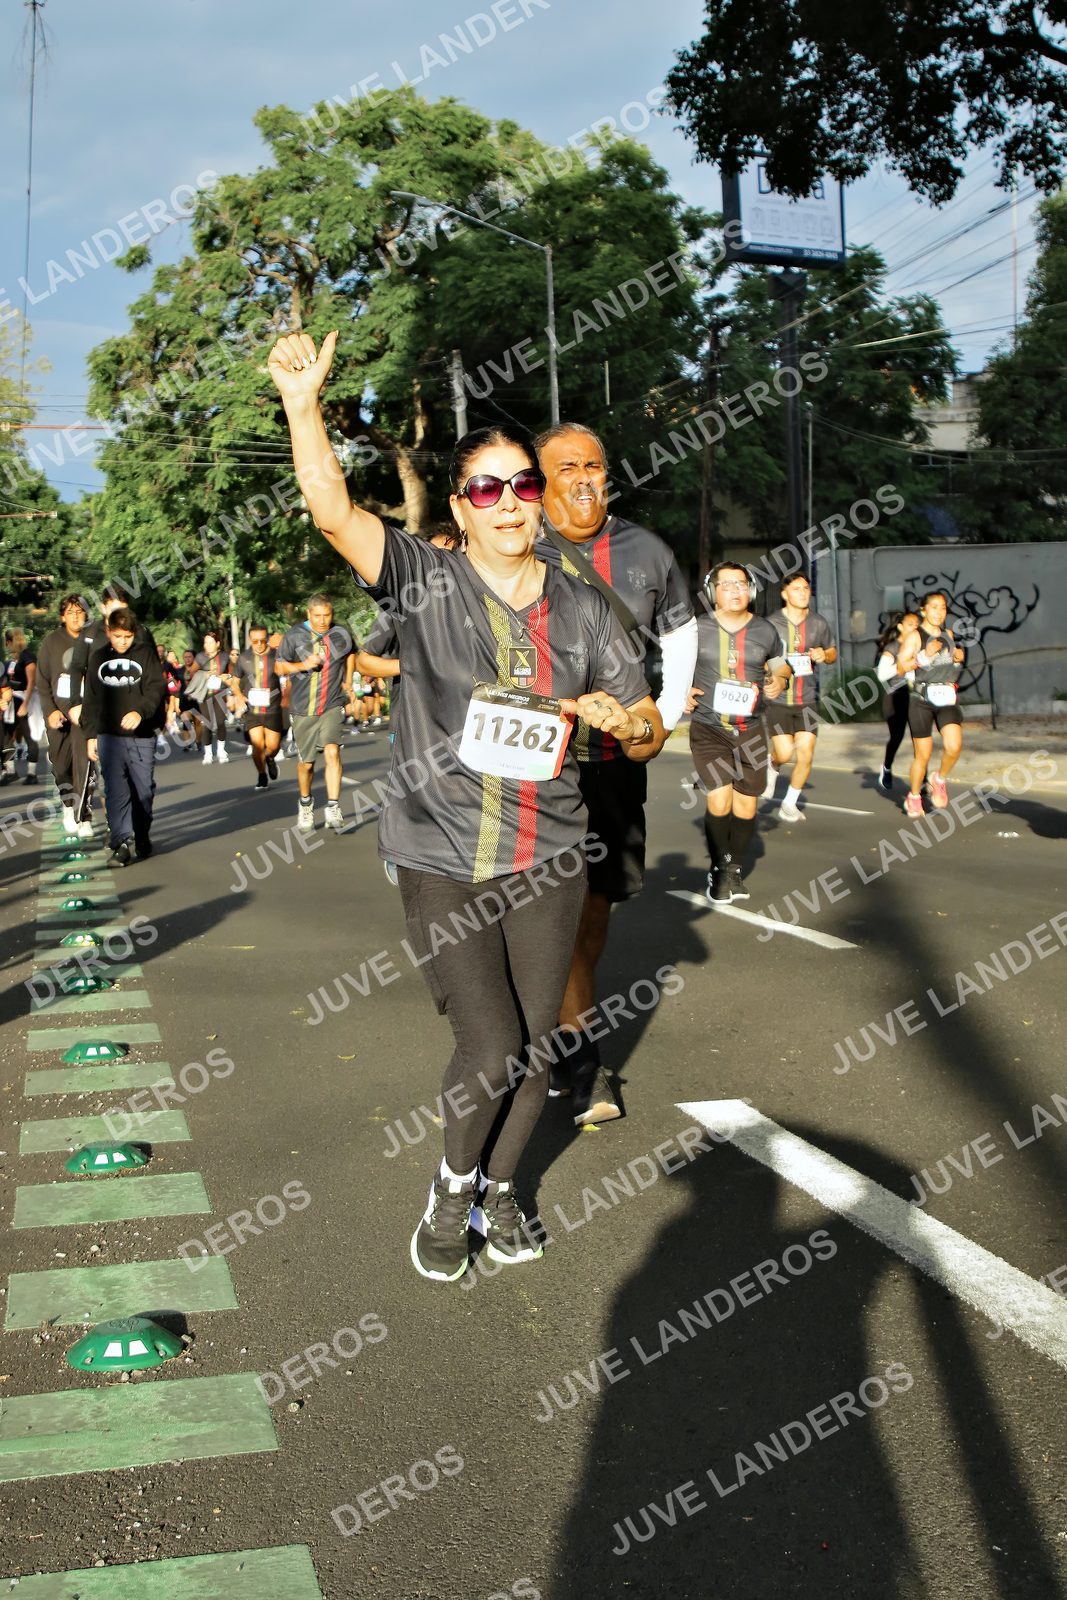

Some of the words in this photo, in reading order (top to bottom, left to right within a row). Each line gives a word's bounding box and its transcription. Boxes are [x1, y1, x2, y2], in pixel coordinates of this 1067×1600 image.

[905, 570, 960, 591] TOY
[721, 689, 749, 703] 9620
[474, 712, 558, 753] 11262
